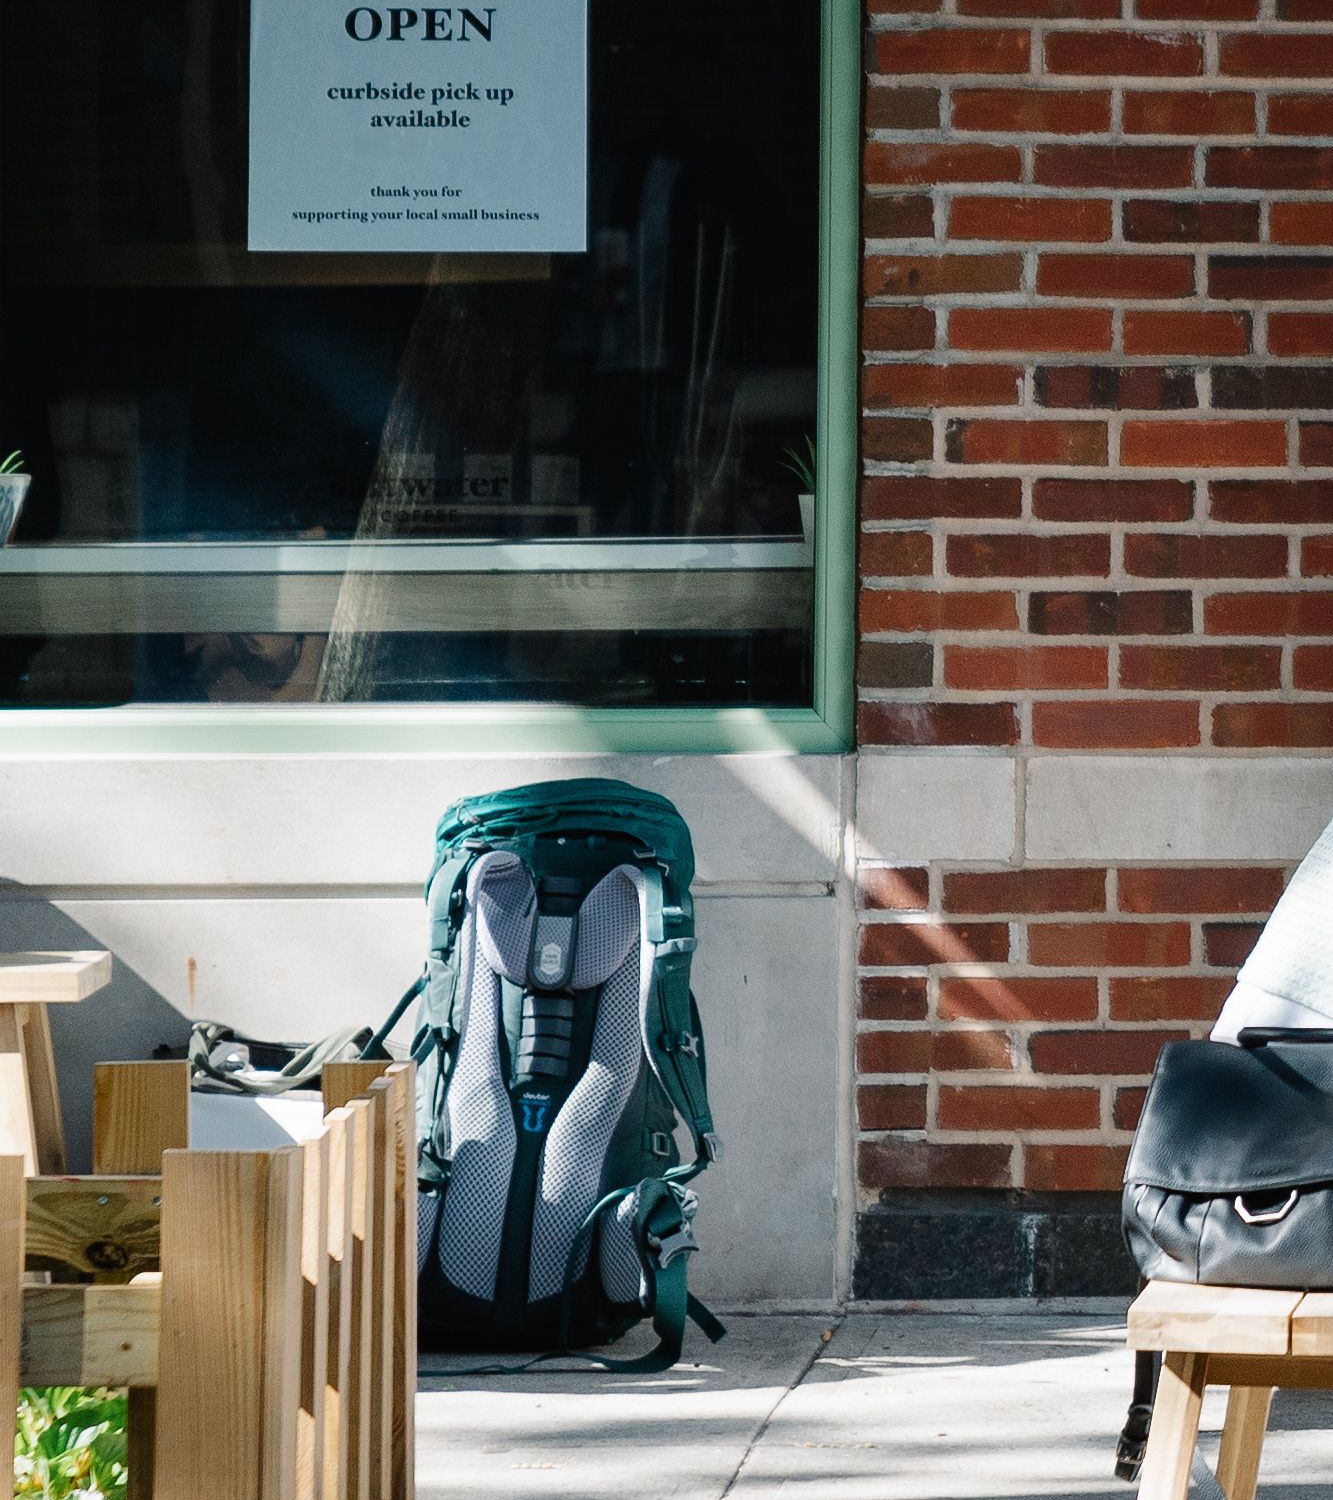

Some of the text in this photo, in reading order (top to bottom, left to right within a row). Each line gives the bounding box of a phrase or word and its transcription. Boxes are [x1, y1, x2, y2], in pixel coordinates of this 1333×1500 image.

[345, 7, 497, 41] OPEN
[327, 82, 513, 106] curbside pick up
[371, 110, 470, 127] available
[371, 186, 462, 200] thank you for
[293, 209, 539, 223] supporting your local small business
[381, 508, 459, 523] COFFEE
